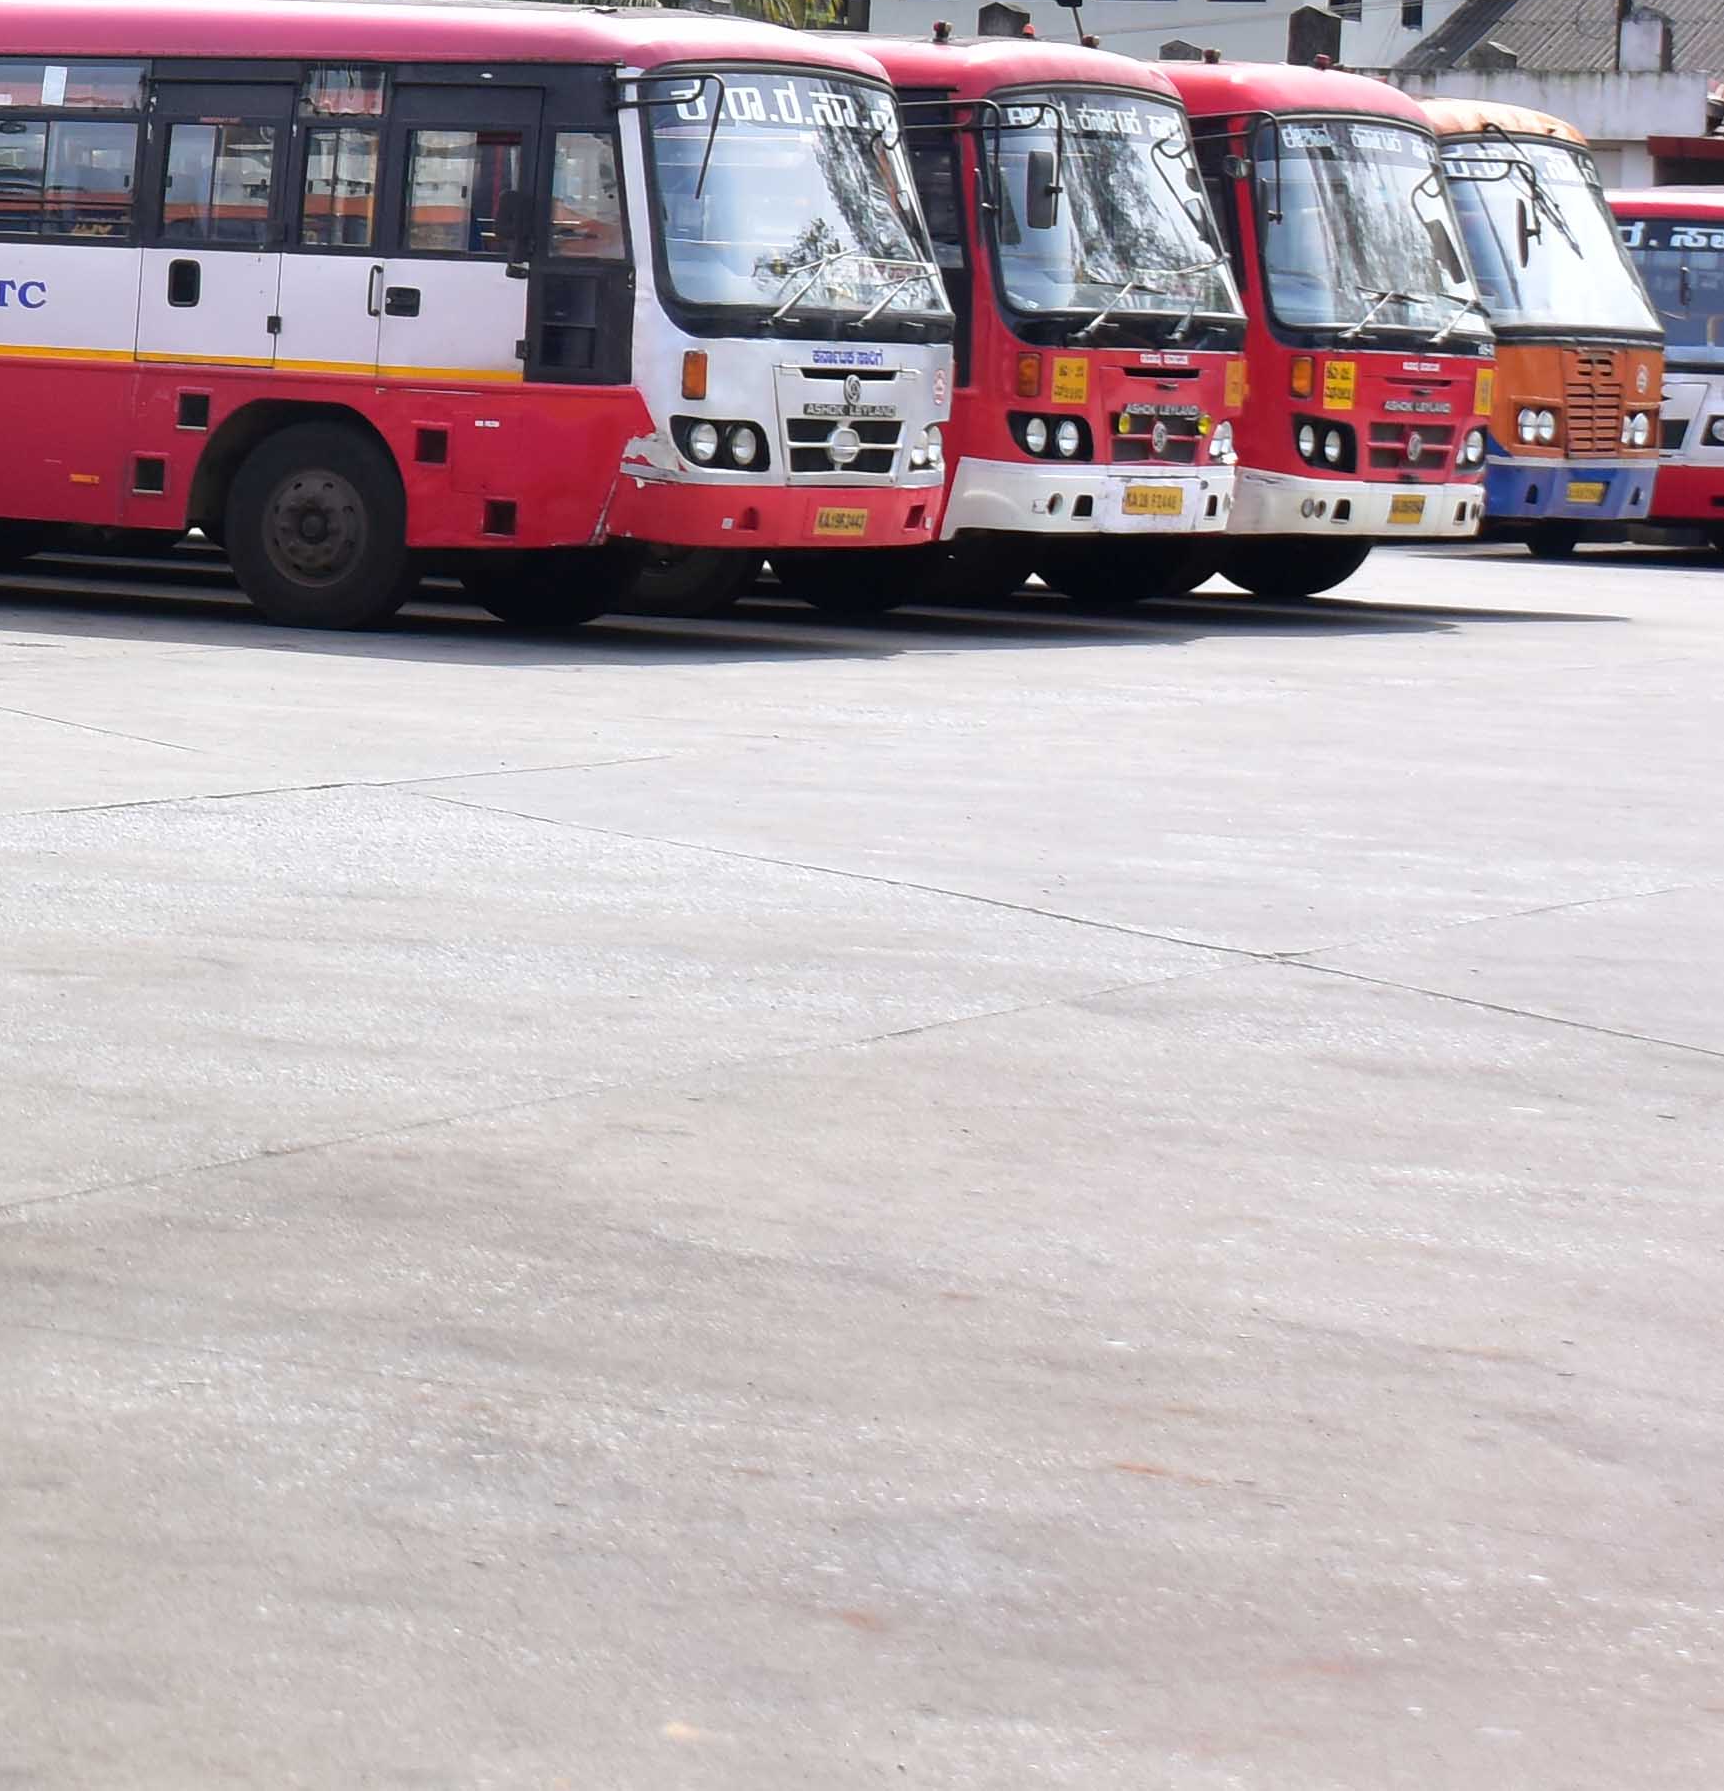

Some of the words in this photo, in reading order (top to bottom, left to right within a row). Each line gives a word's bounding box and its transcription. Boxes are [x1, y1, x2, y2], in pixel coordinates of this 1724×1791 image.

[807, 404, 845, 416] ASHOK
[849, 405, 896, 417] LEYLAND
[1125, 403, 1156, 415] ASHOK
[1158, 404, 1200, 416] LEYLAND
